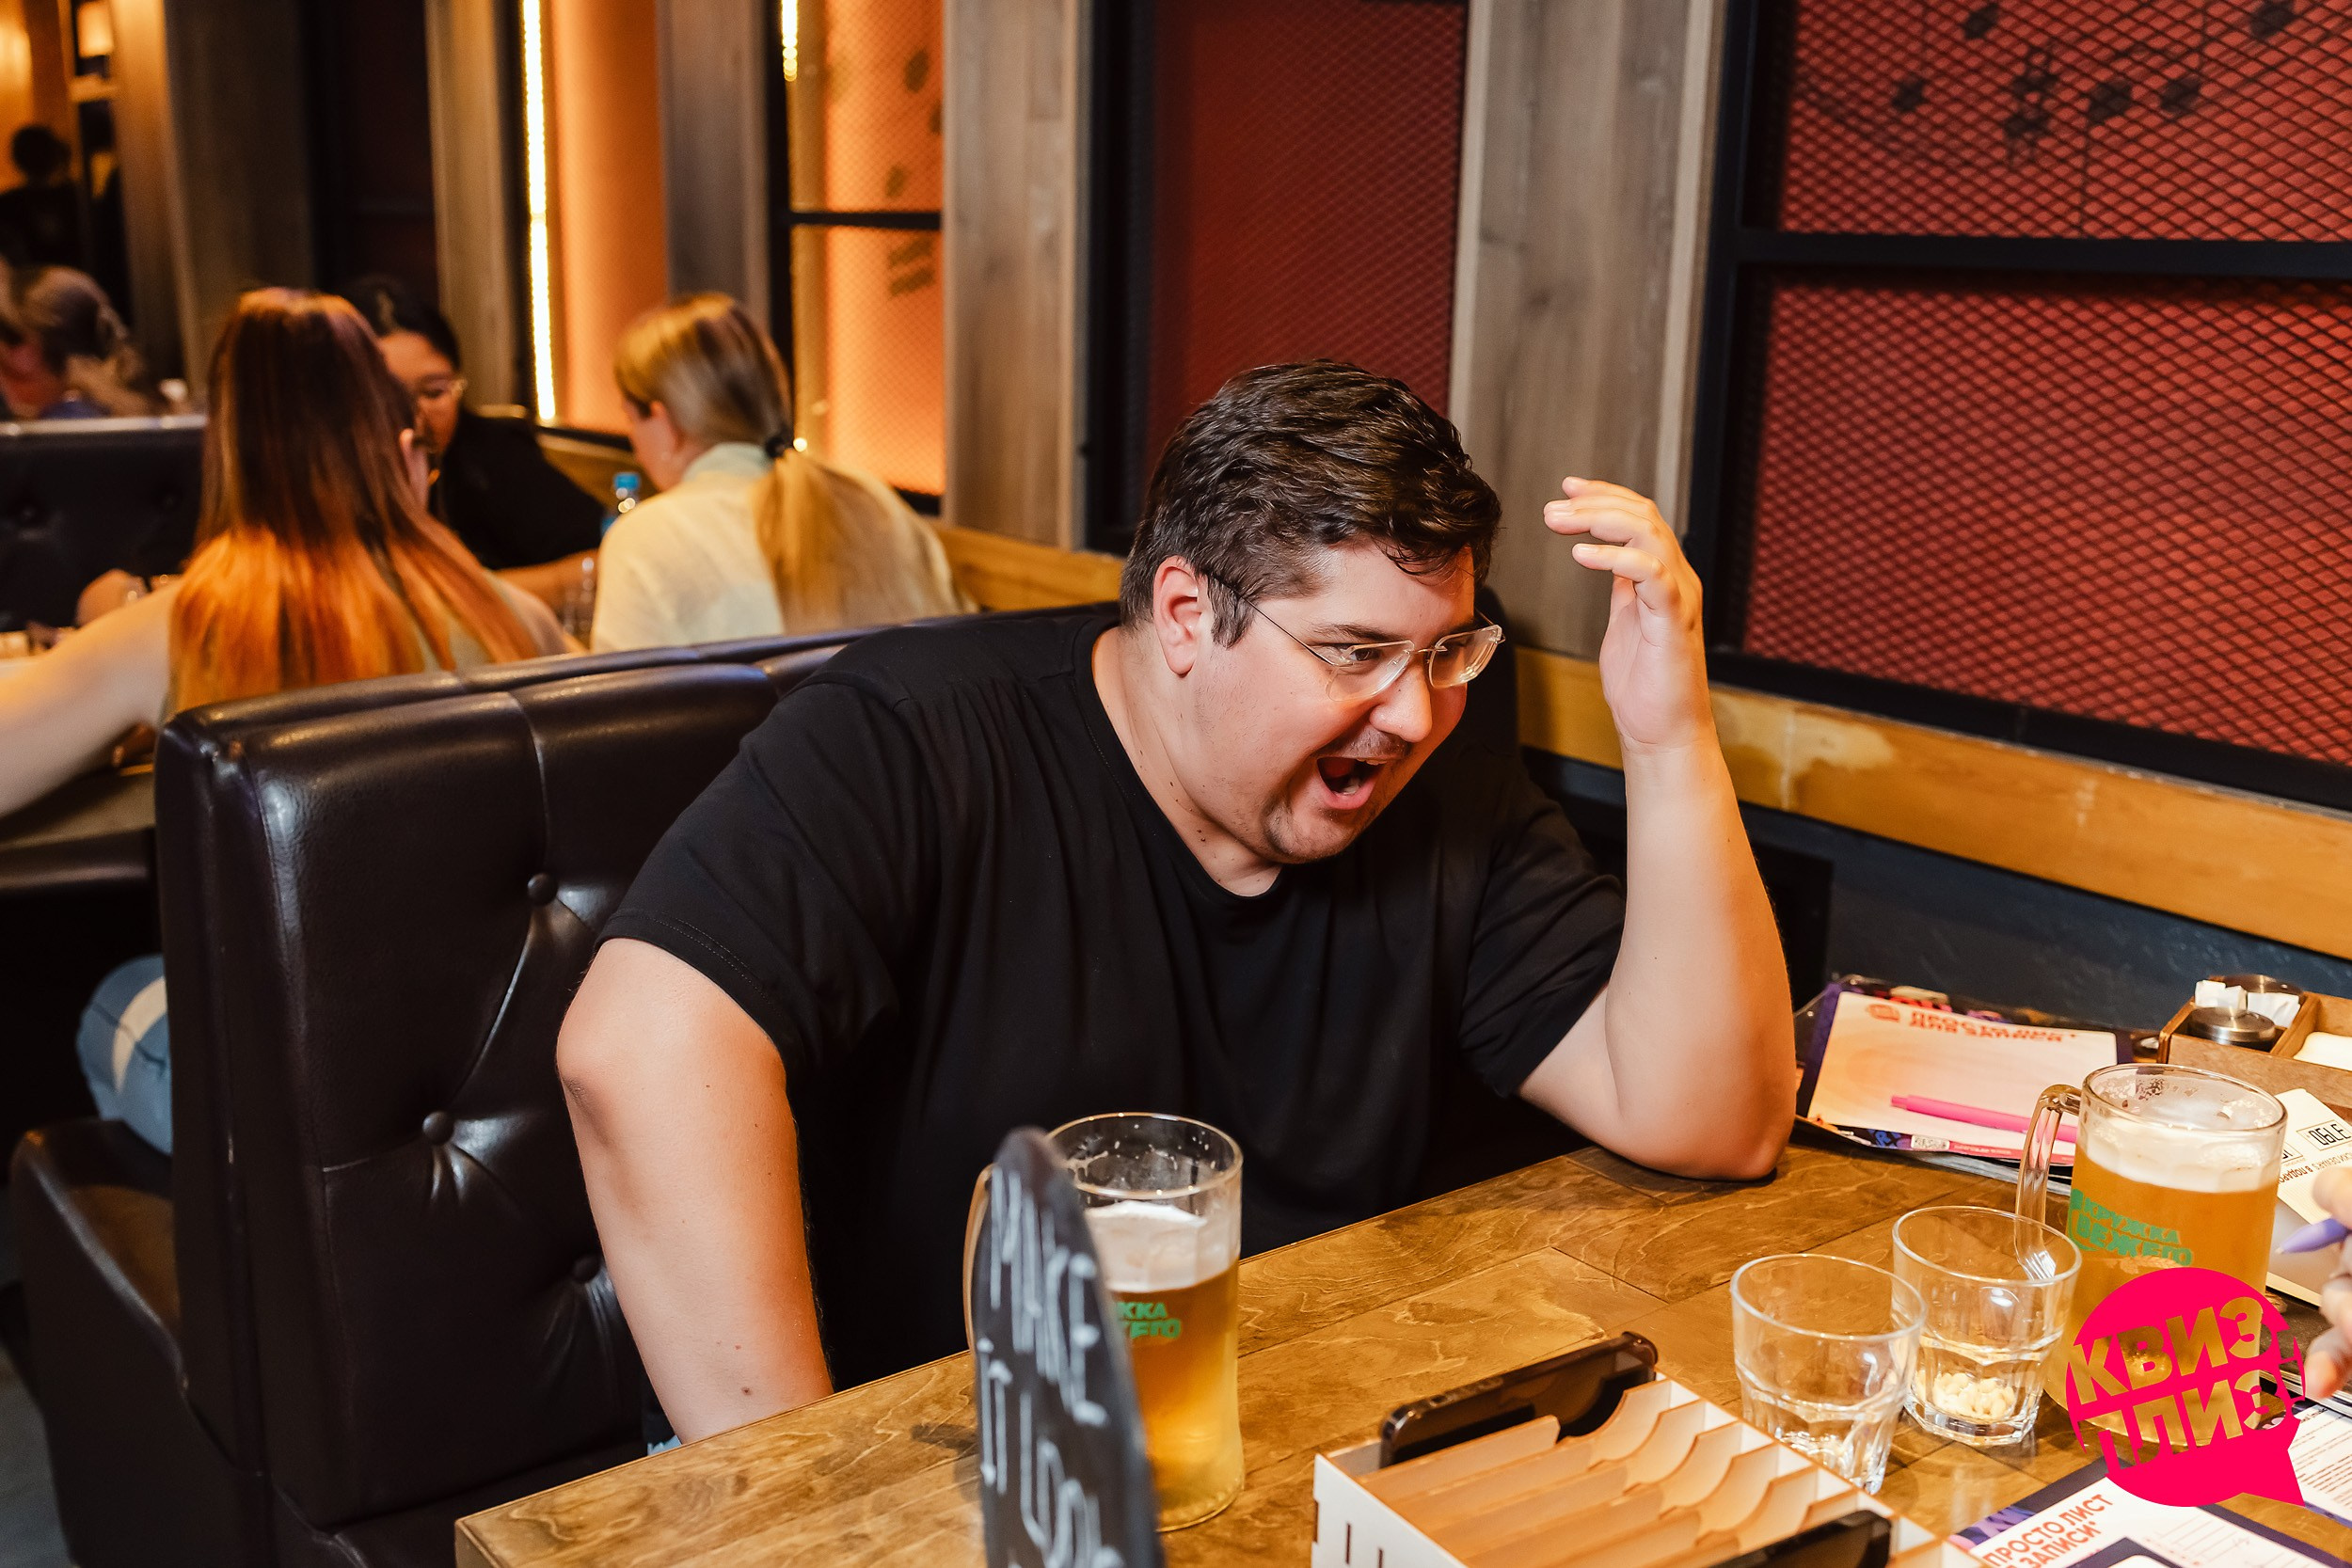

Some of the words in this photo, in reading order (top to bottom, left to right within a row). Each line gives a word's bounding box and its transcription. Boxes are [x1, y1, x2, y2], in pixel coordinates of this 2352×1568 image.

[2278, 1167, 2308, 1184] ПОДАРО
[2083, 1197, 2181, 1244] КРУЖКА
[1982, 1521, 2065, 1567] ПРОСТО
[2058, 1494, 2113, 1526] ЛИСТ
